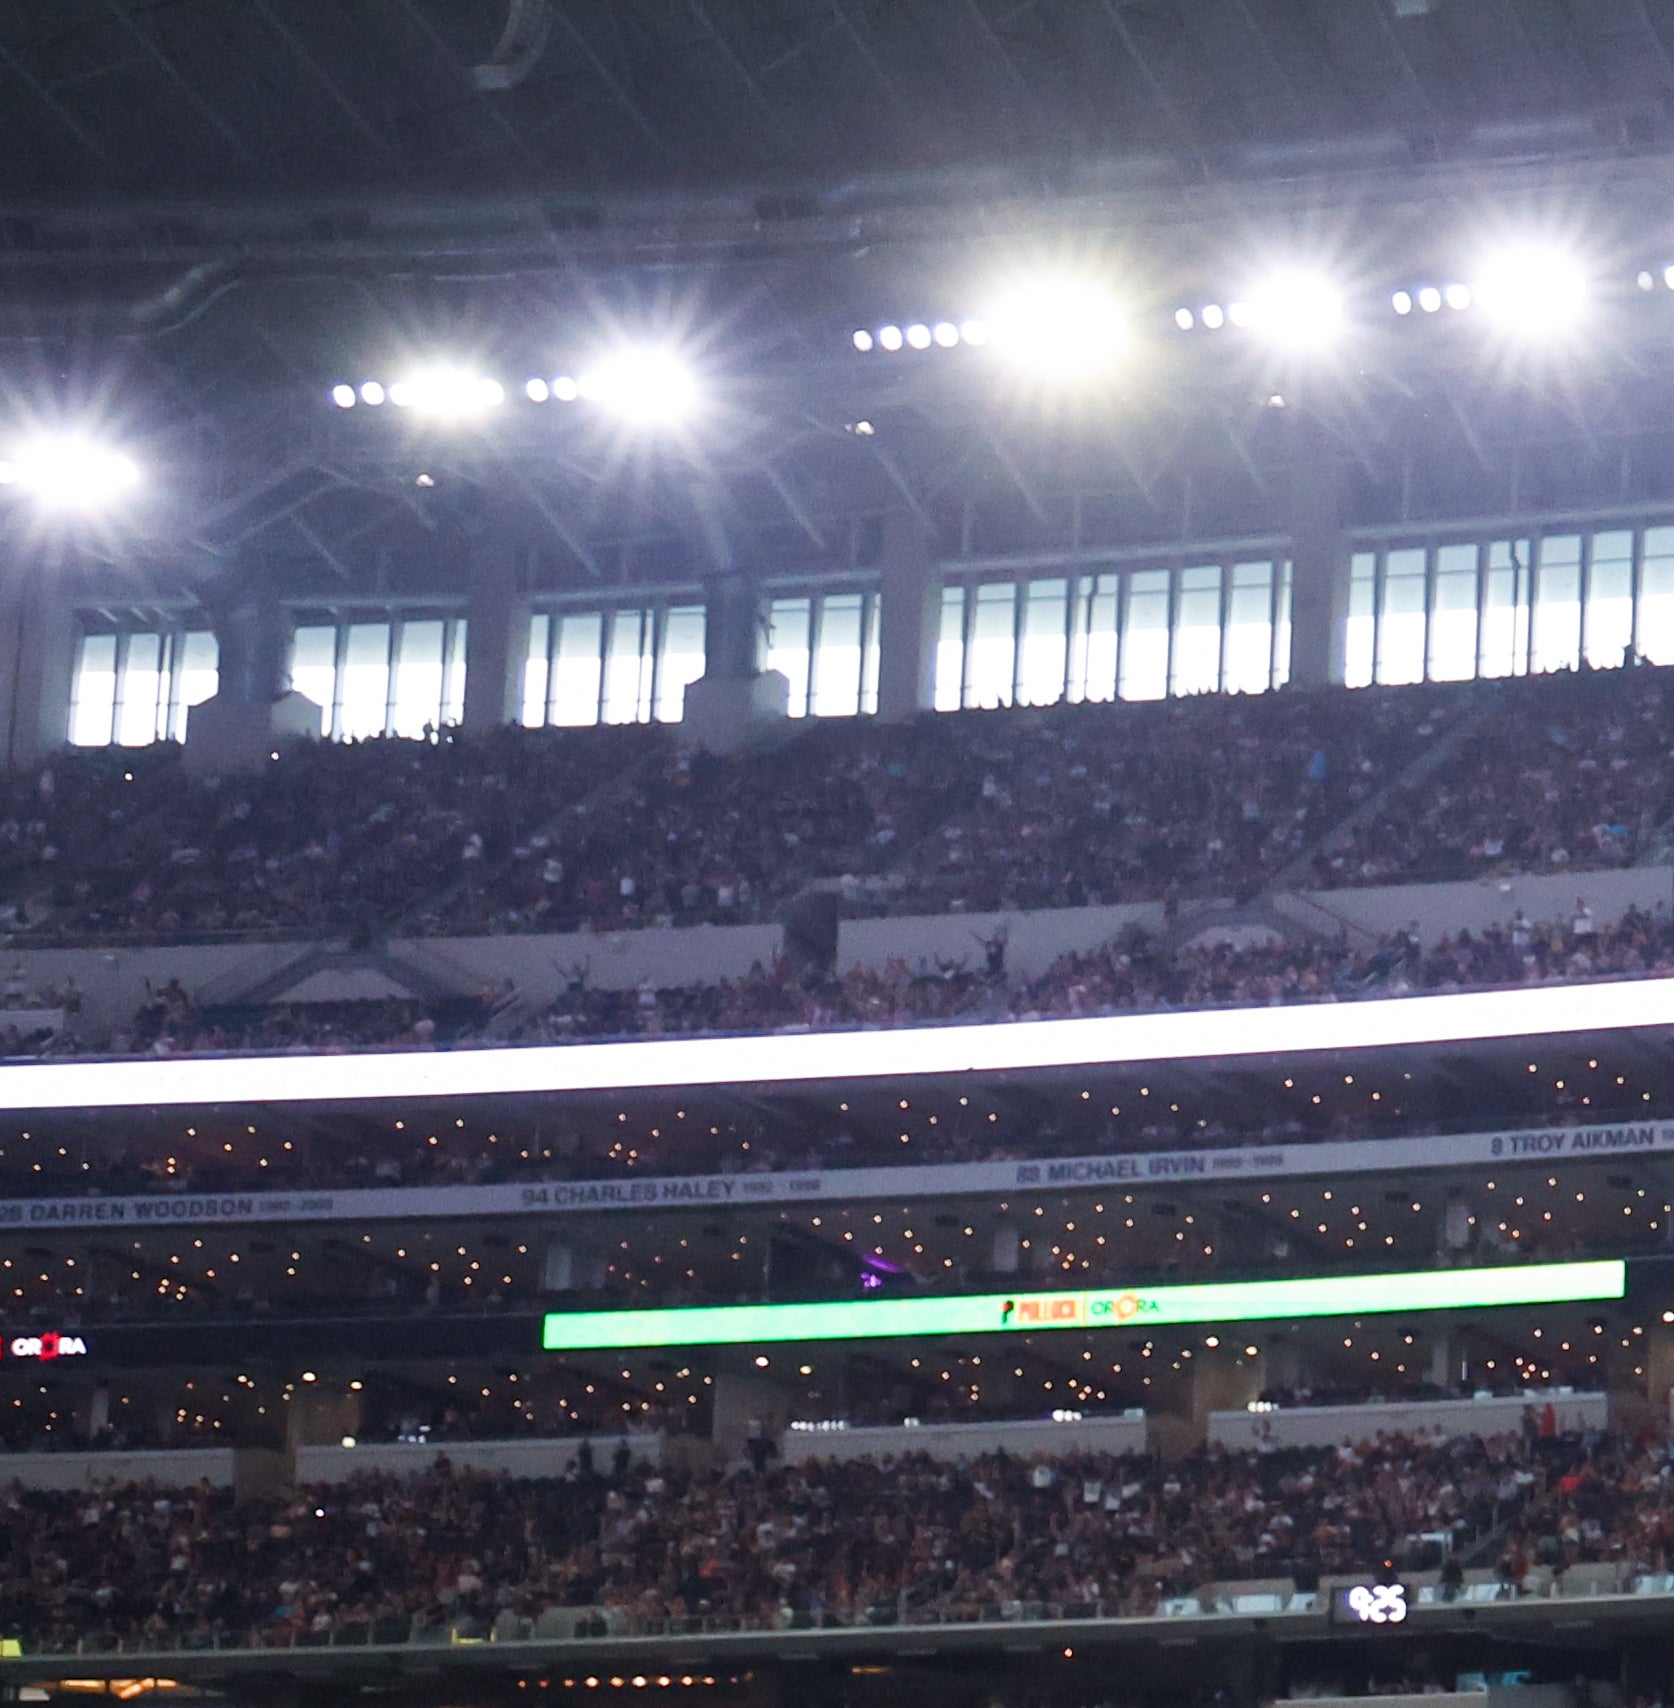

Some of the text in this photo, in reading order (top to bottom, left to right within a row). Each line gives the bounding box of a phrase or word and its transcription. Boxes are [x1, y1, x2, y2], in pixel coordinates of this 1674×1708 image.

[1511, 1132, 1566, 1154] TROY
[1571, 1128, 1654, 1149] AIKMAN
[1047, 1159, 1140, 1181] MICHAEL
[1149, 1156, 1205, 1175] IRVIN
[554, 1184, 657, 1202] CHARLES
[662, 1180, 735, 1199] HALEY
[31, 1203, 125, 1221] DARREN
[136, 1199, 253, 1219] WOODSON
